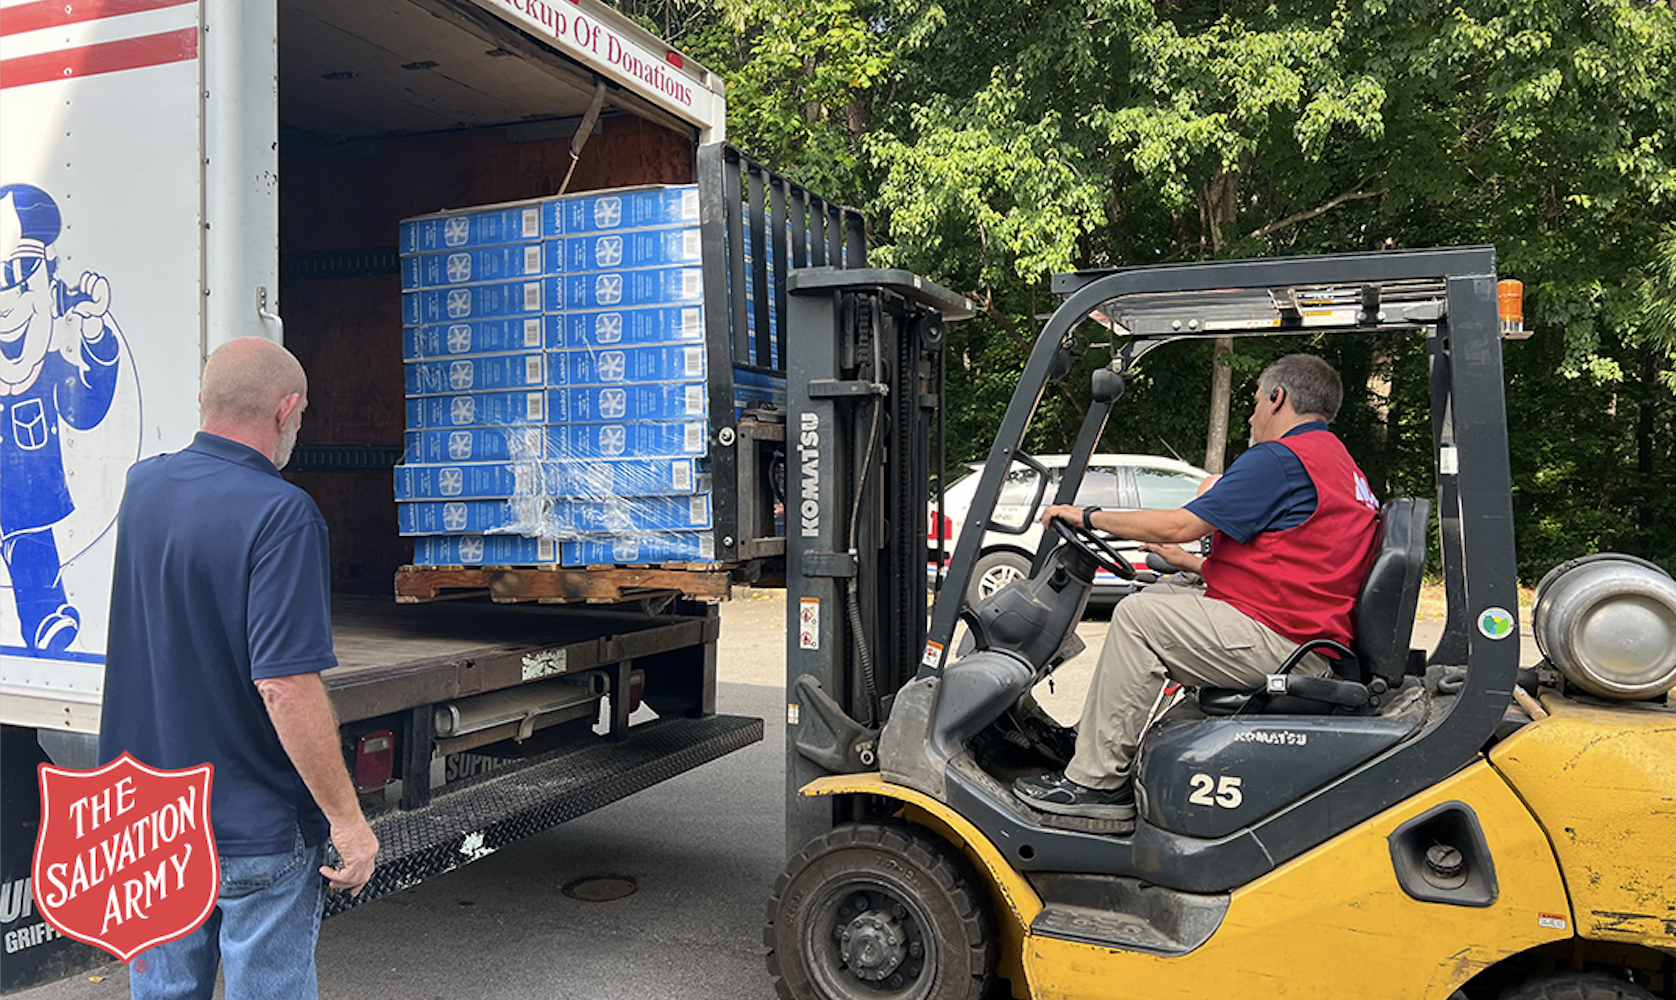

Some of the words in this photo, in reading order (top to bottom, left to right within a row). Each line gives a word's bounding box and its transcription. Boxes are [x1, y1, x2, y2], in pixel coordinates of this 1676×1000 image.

[504, 0, 567, 38] ckup
[574, 16, 600, 54] Of
[606, 33, 693, 107] Donations
[797, 413, 819, 537] KOMATSU
[1234, 731, 1307, 745] KOMATSU
[1188, 773, 1243, 809] 25
